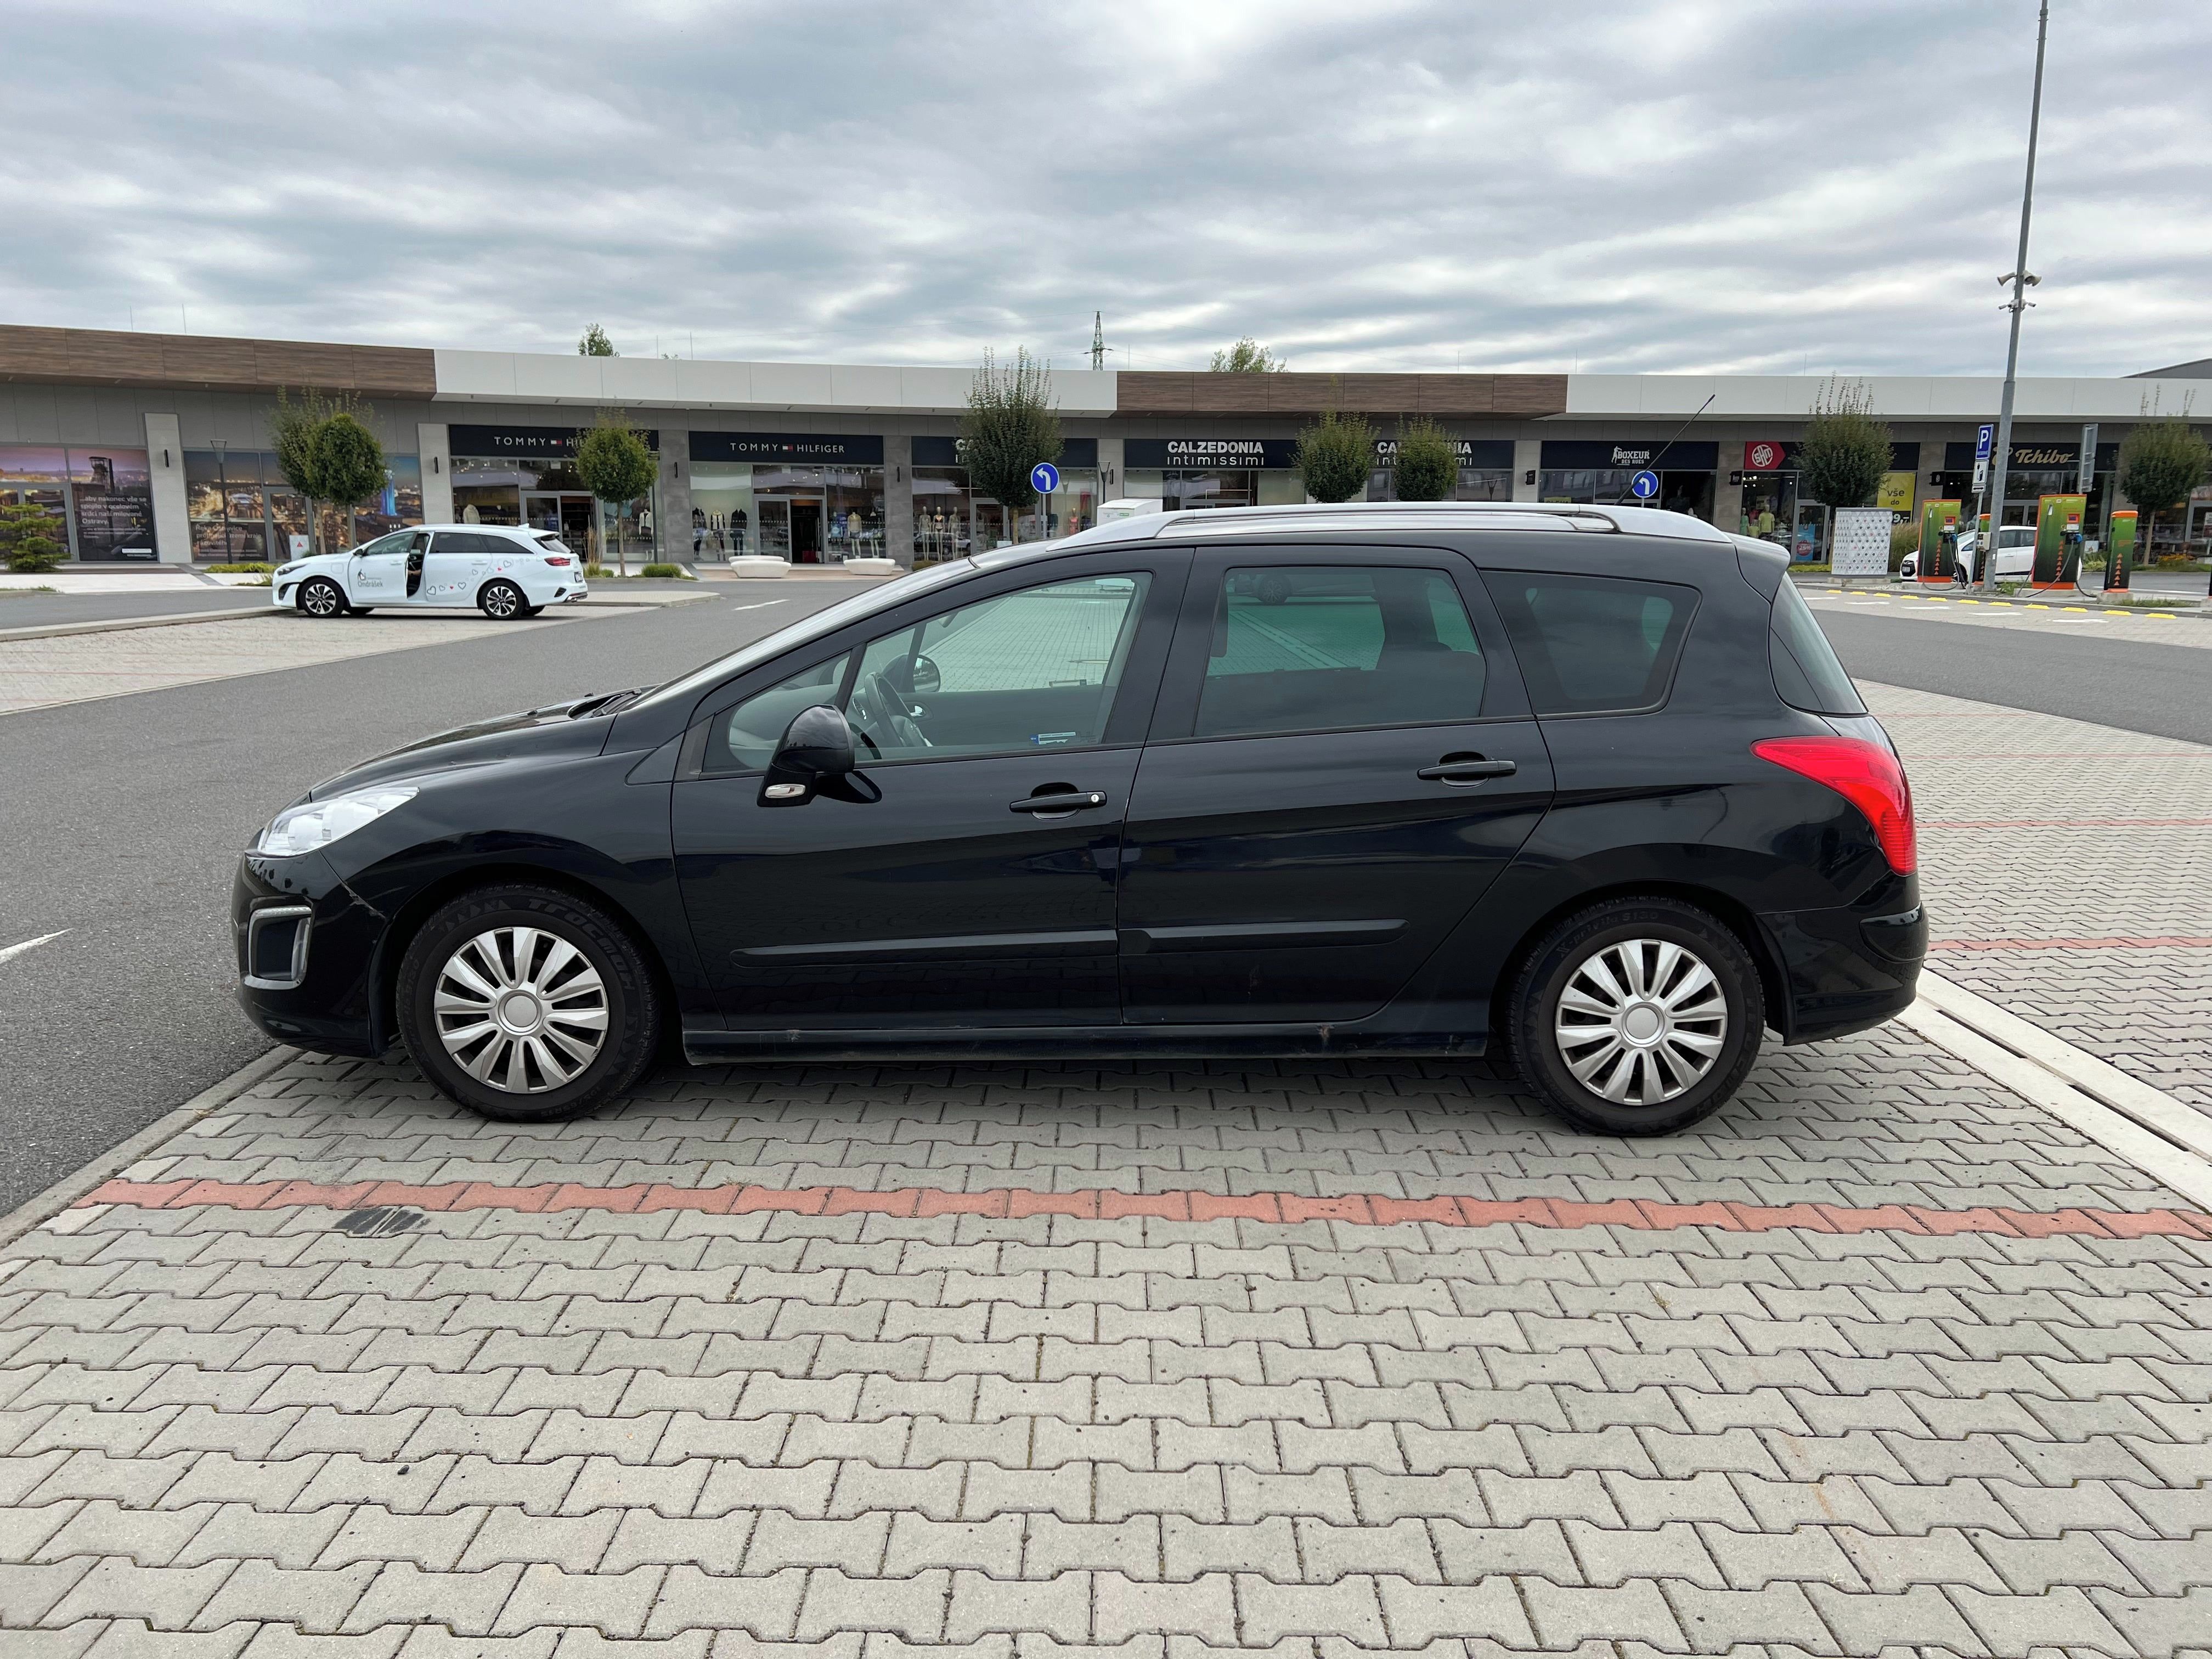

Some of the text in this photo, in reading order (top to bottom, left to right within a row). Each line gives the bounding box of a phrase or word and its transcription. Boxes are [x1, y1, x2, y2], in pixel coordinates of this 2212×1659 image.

[494, 437, 546, 446] TOMMY
[1979, 430, 1989, 449] P
[730, 443, 844, 453] TOMMY HILFIGER
[1167, 441, 1264, 453] CALZEDONIA
[1617, 451, 1650, 459] BOXEUR
[2015, 449, 2074, 464] Tchibo
[1167, 455, 1264, 466] intimissimi
[1887, 488, 1905, 497] vše
